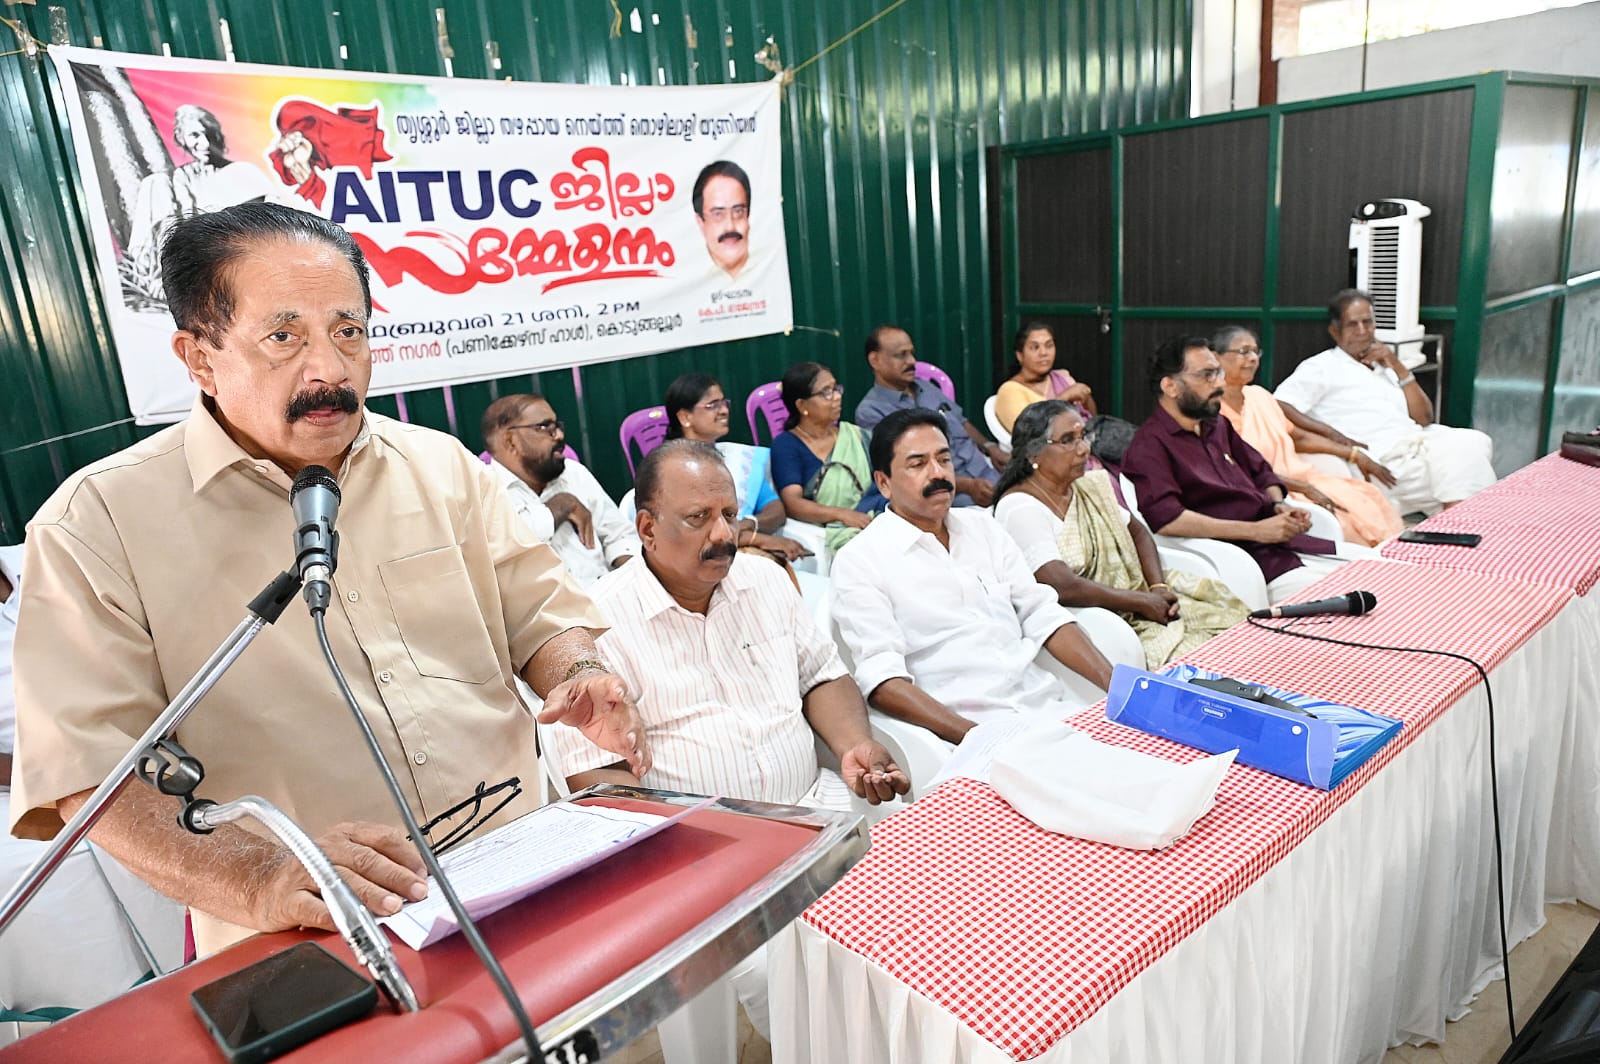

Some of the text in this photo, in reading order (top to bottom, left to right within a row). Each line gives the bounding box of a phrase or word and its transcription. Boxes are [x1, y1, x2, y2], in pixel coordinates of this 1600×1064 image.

[455, 111, 495, 144] ജില്ലാ
[630, 112, 696, 142] തൊഴിലാളി
[331, 146, 675, 223] AITUC ജില്ലാ
[501, 312, 524, 326] 21
[532, 304, 589, 323] ശനി,
[597, 303, 609, 316] 2
[613, 301, 640, 314] PM
[399, 340, 441, 361] നഗർ
